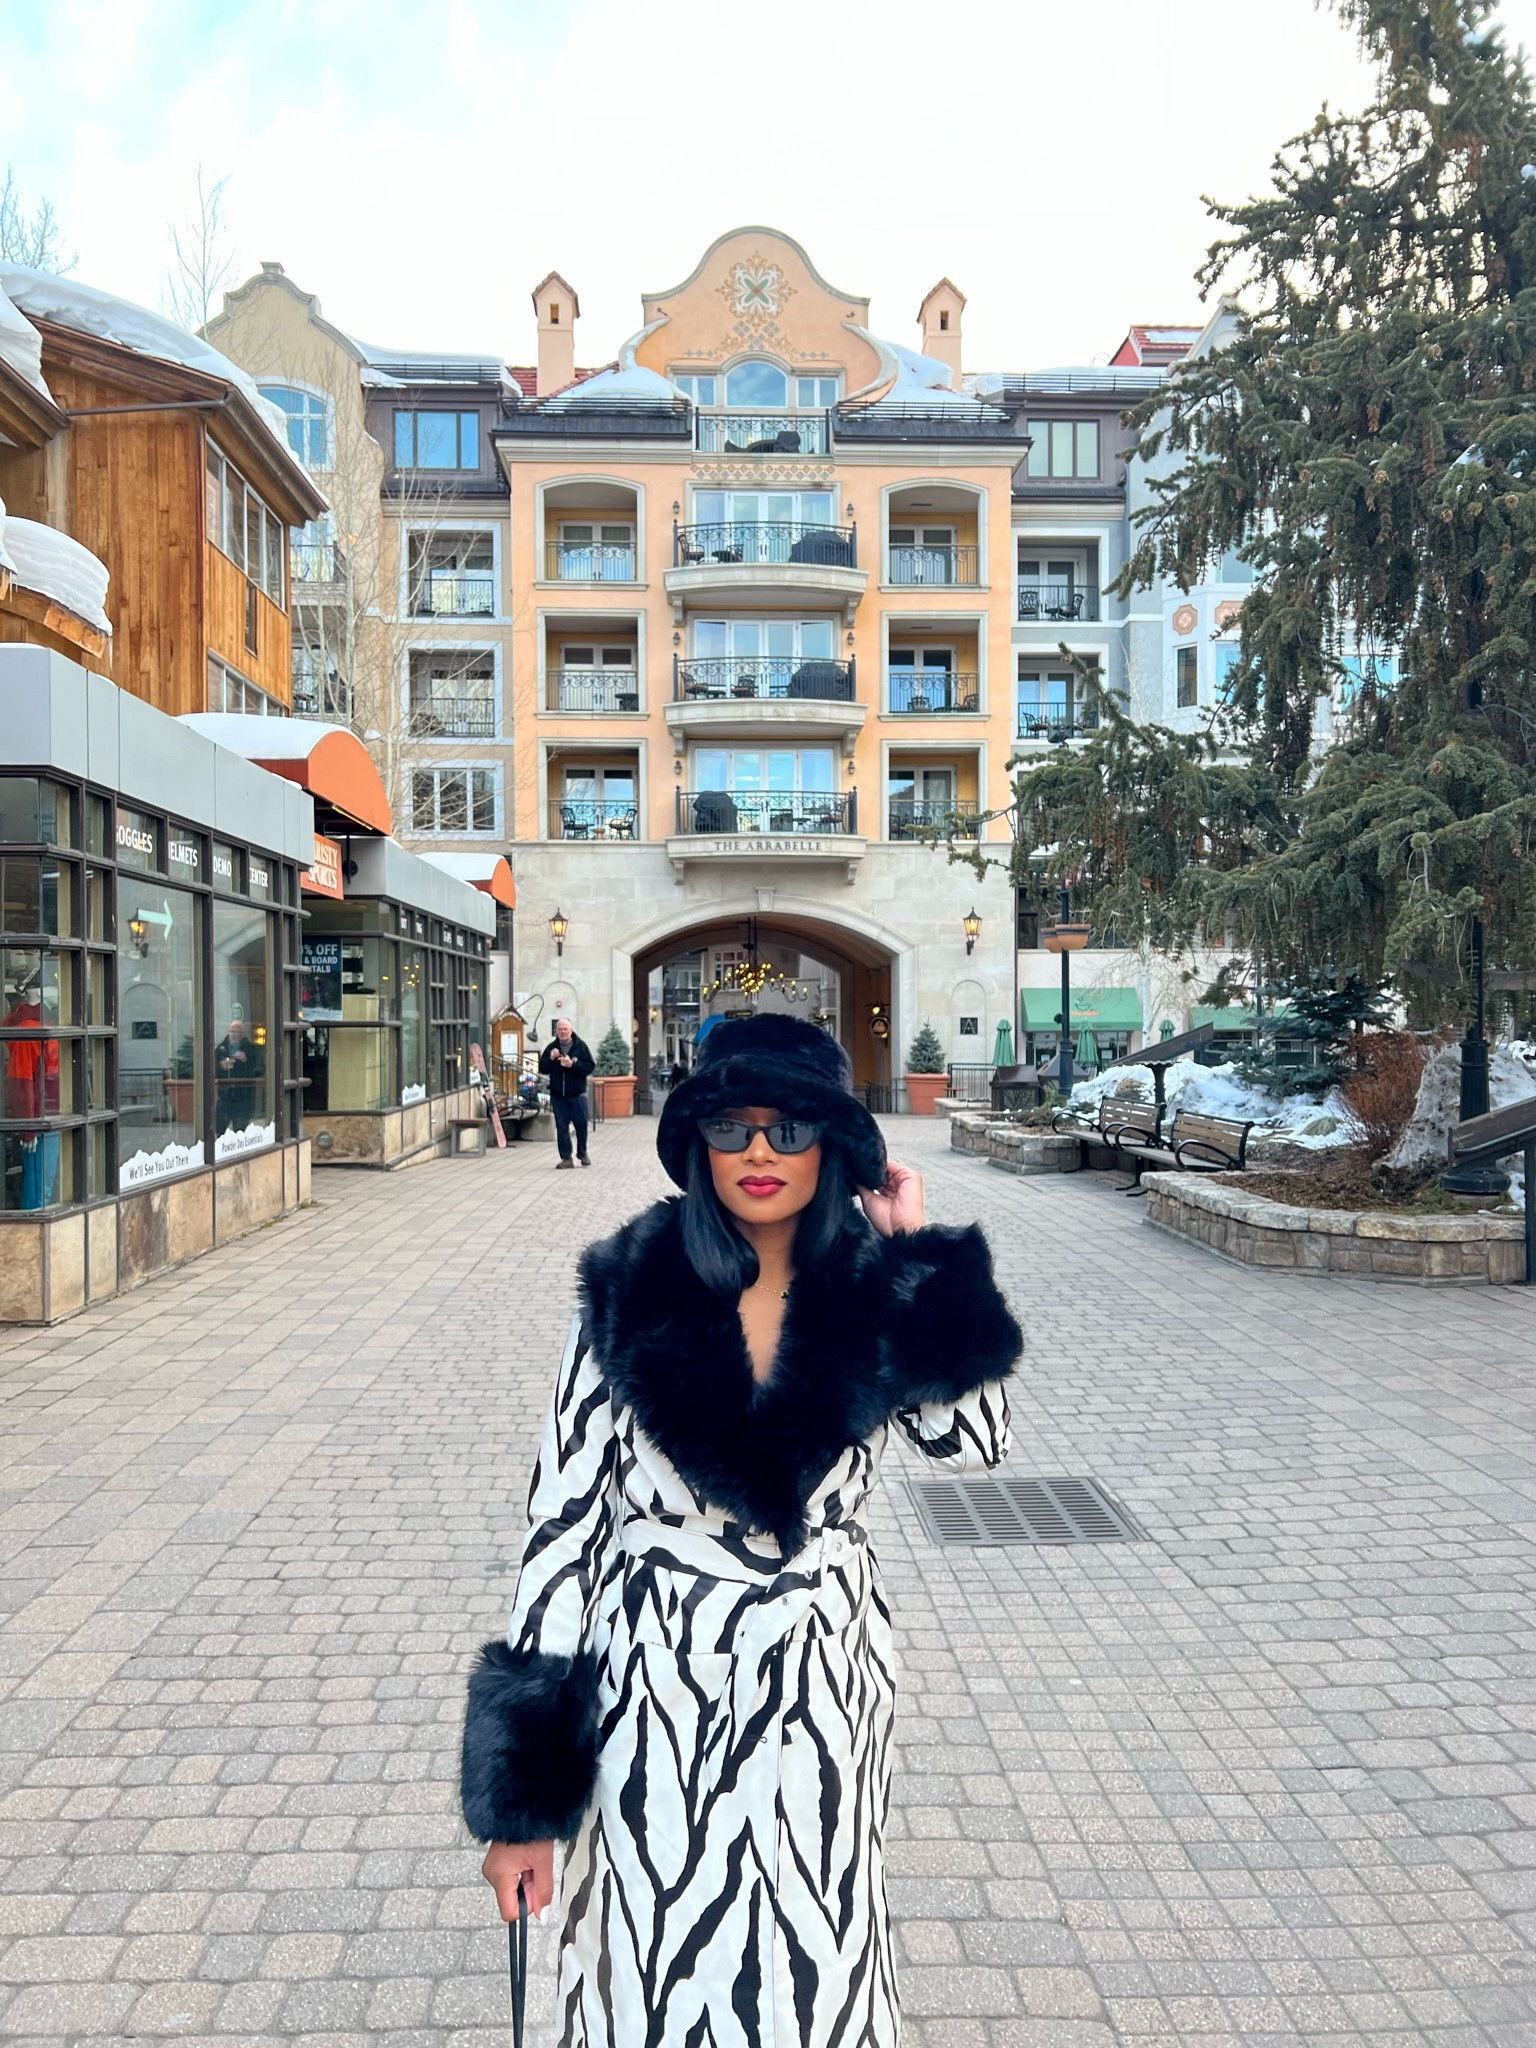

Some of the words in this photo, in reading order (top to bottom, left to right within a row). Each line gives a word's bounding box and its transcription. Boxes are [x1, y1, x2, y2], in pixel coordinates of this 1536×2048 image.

[714, 842, 740, 851] THE
[746, 842, 823, 851] ARRABELLE
[213, 855, 232, 877] DEMO
[308, 862, 338, 890] SPORTS
[316, 944, 338, 955] OFF
[304, 956, 310, 965] &
[311, 956, 338, 965] BOARD
[144, 1163, 154, 1176] See
[155, 1160, 165, 1172] You
[165, 1158, 175, 1170] Out
[175, 1155, 188, 1168] There
